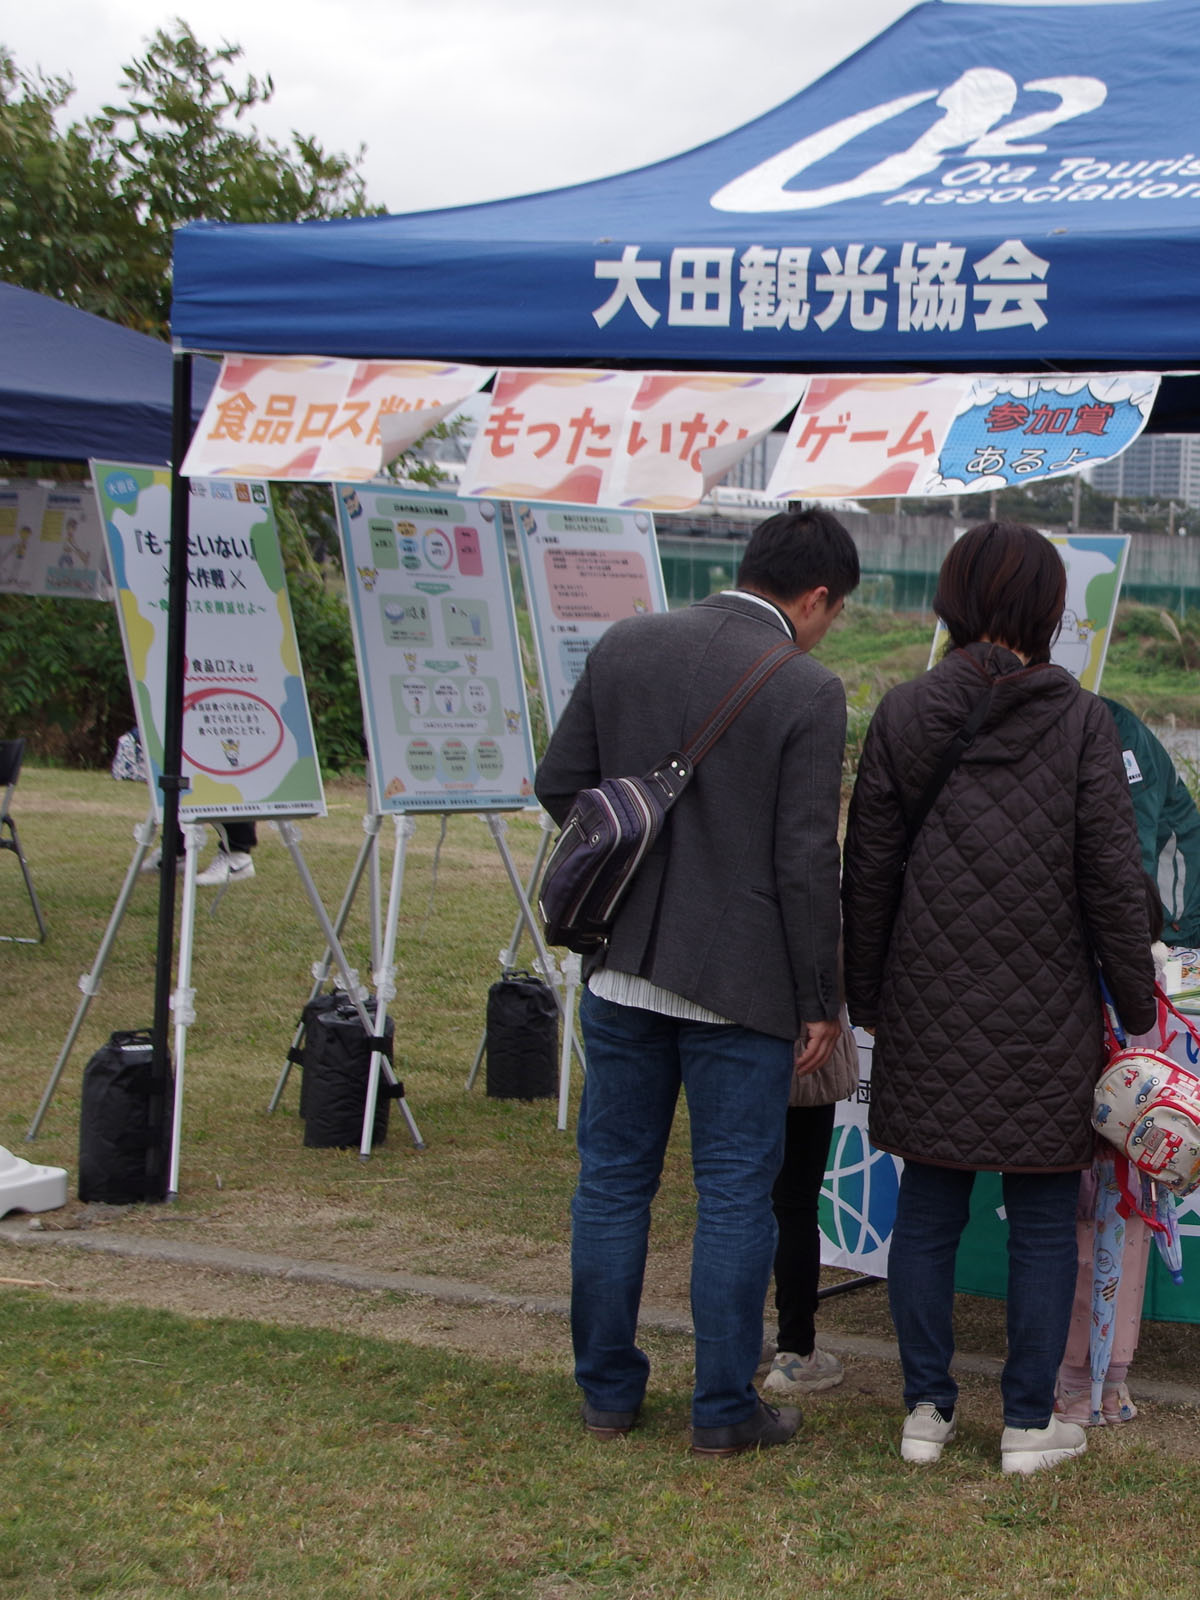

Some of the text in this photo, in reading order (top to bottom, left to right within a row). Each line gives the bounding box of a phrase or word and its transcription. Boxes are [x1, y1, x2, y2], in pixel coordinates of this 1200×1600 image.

[941, 160, 1037, 187] Ota
[591, 239, 1050, 332] 大田観光協会
[207, 391, 442, 446] 食品ロス削
[795, 410, 937, 463] ゲーム
[983, 401, 1115, 437] 参加賞
[483, 407, 749, 474] もったいな
[965, 445, 1090, 475] あるよ
[135, 528, 256, 561] 『もたいない』
[192, 658, 254, 674] 食品ロスとは
